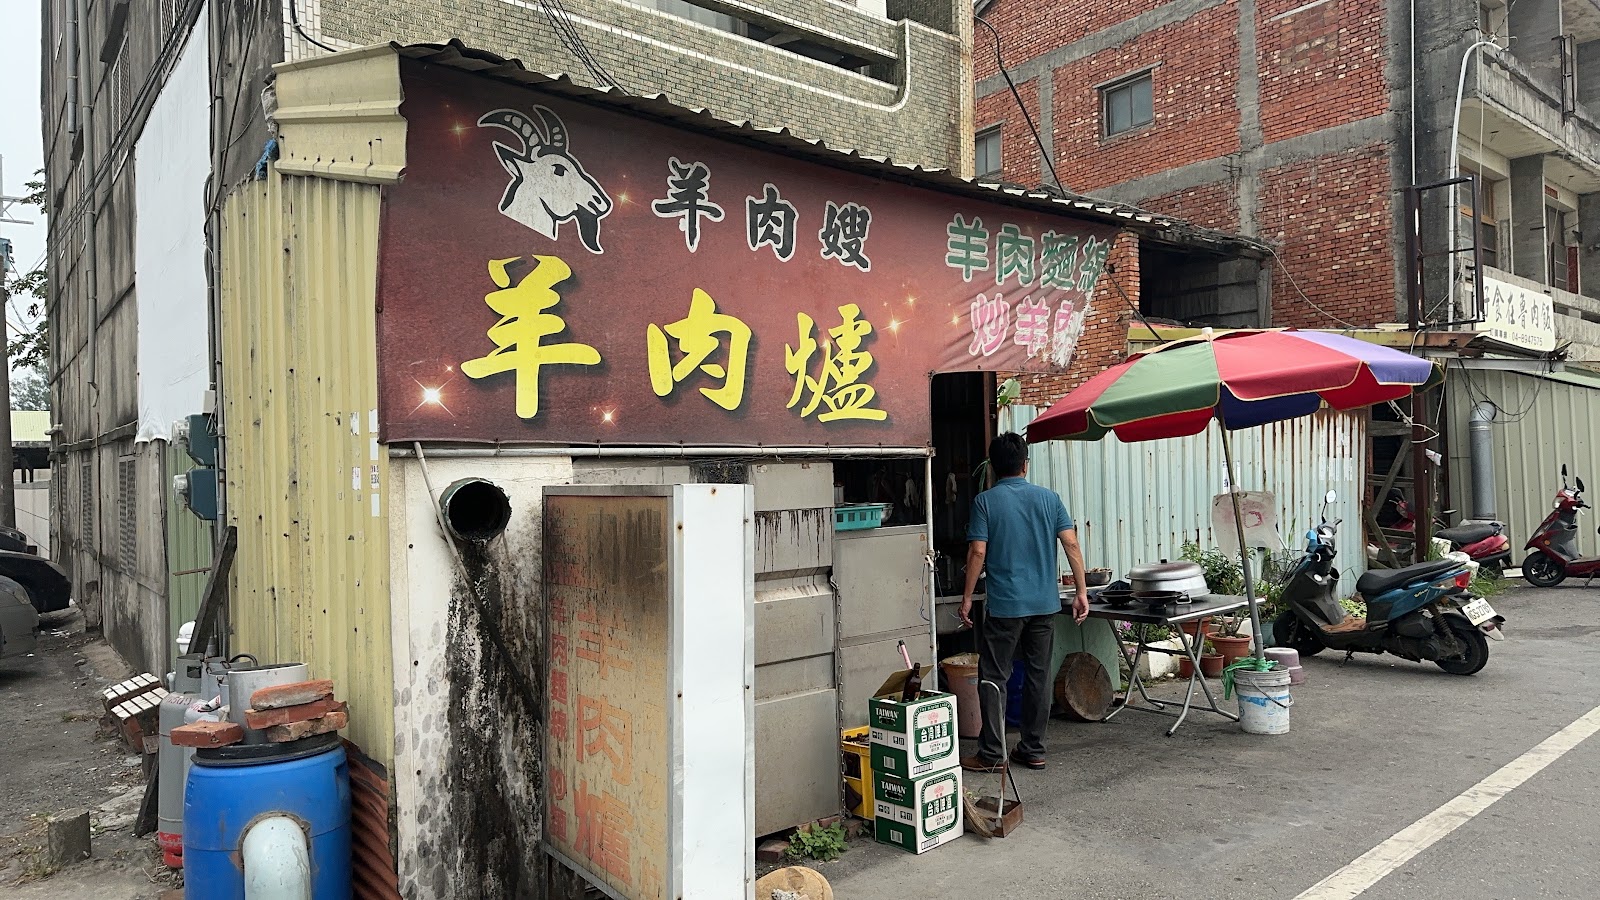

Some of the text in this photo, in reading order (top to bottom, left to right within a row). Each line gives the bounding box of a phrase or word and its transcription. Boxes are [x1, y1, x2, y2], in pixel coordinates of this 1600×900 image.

[651, 156, 872, 273] 羊肉嫂
[945, 212, 1110, 293] 羊肉麵線
[460, 254, 888, 423] 羊肉爐
[573, 602, 634, 888] 羊肉爐
[875, 707, 899, 719] TAIWAN
[881, 780, 906, 795] TAIWAN
